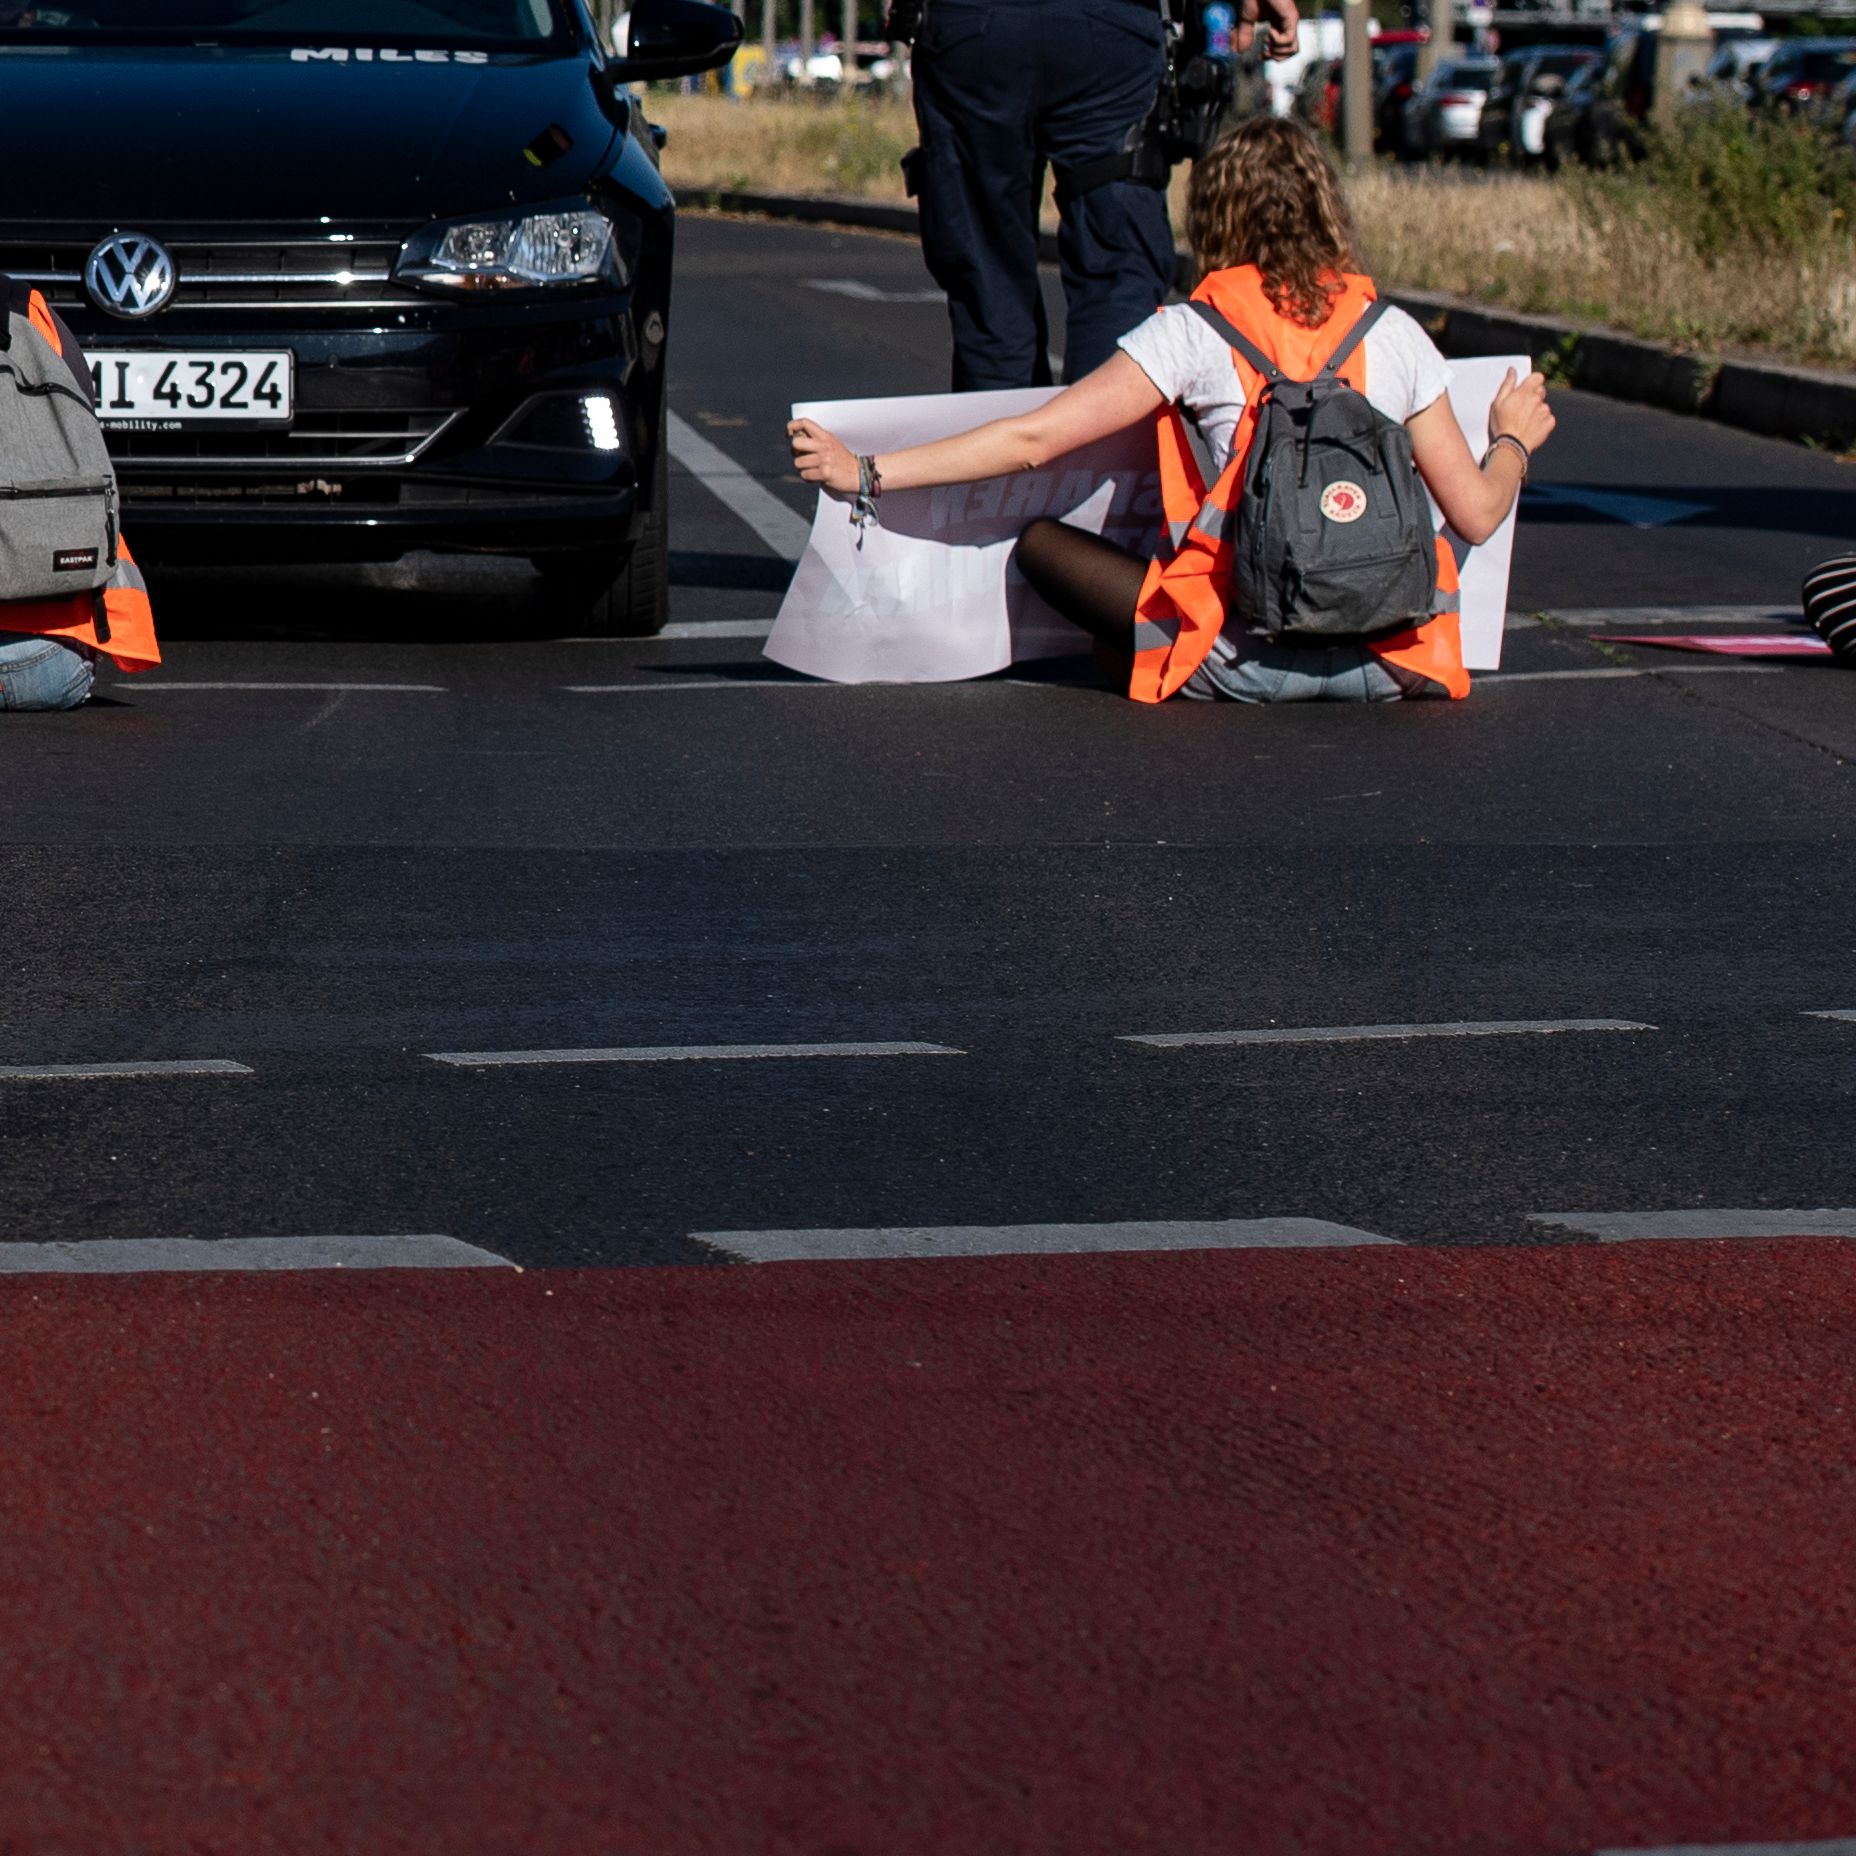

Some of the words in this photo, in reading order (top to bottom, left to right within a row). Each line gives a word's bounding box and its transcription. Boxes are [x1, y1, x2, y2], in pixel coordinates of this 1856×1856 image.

[290, 48, 488, 64] MILES
[152, 360, 282, 409] 4324
[60, 555, 93, 565] EASTPAK
